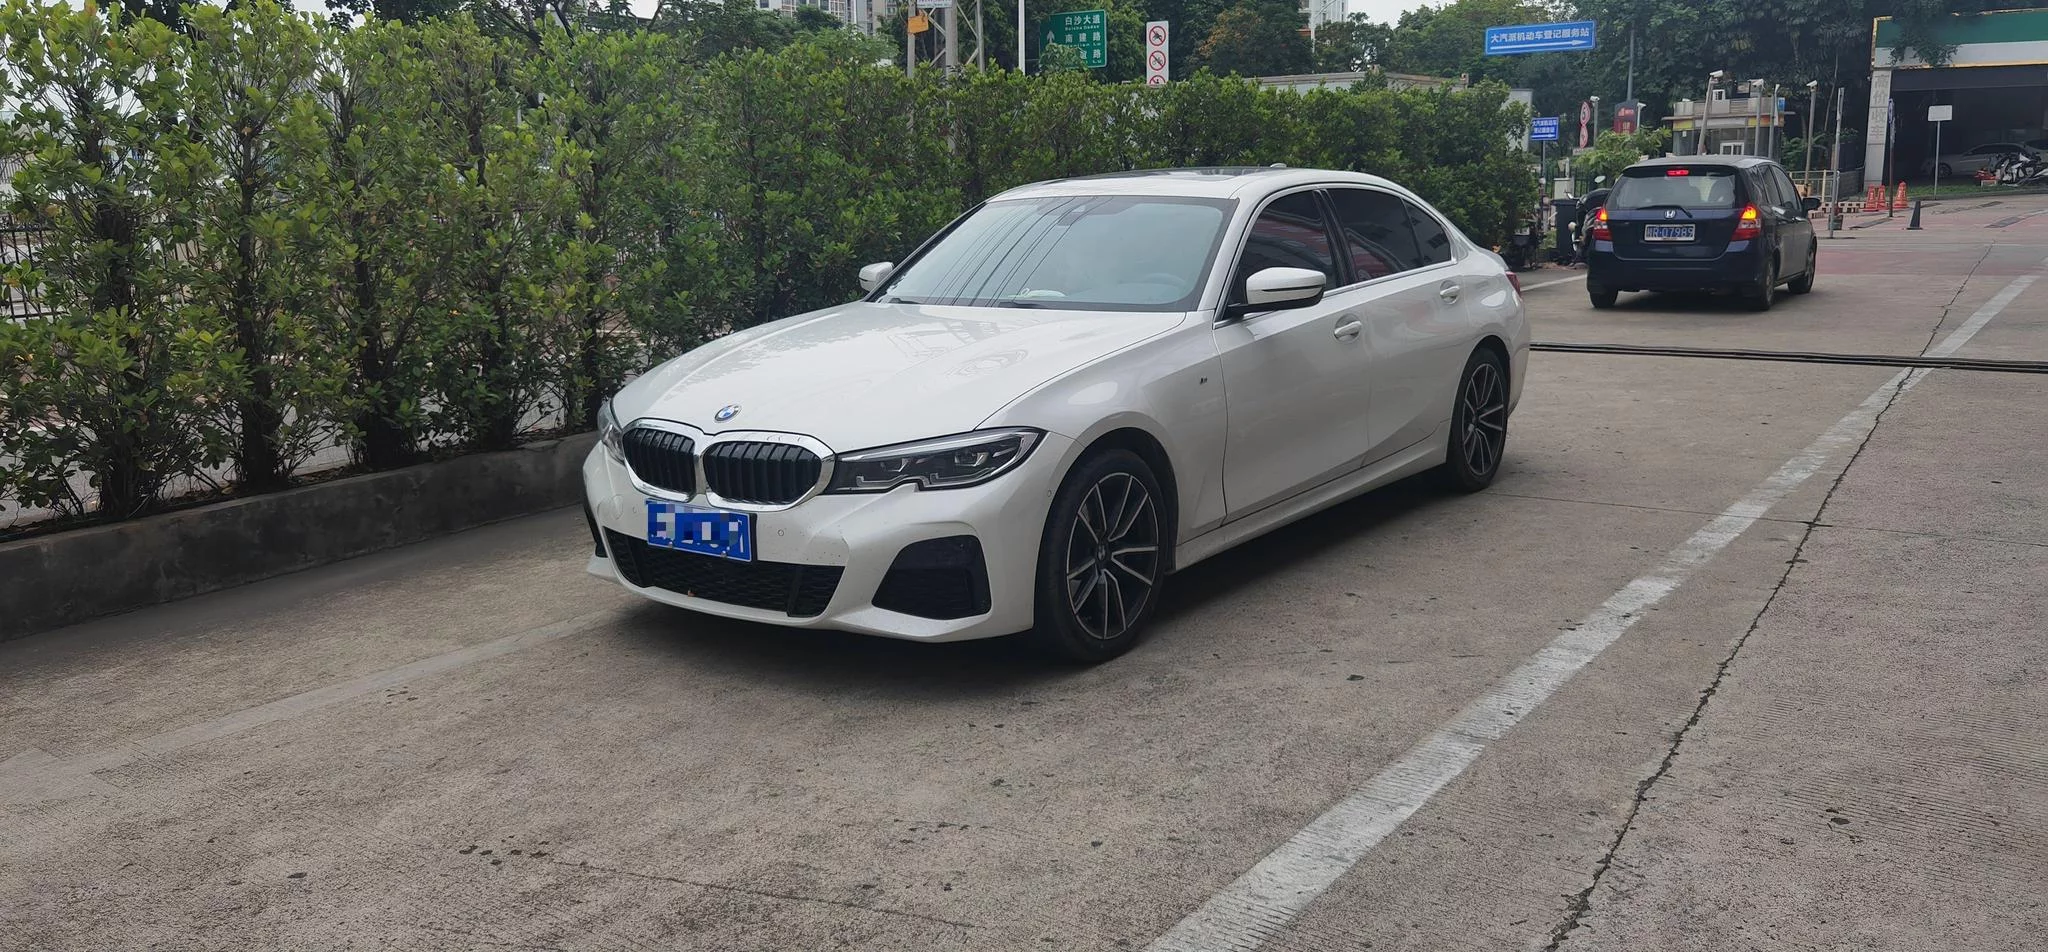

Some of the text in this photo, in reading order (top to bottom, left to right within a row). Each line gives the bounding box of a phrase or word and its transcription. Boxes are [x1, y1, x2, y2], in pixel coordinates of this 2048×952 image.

[1065, 14, 1100, 25] 白沙大道
[1065, 32, 1101, 43] 南建路
